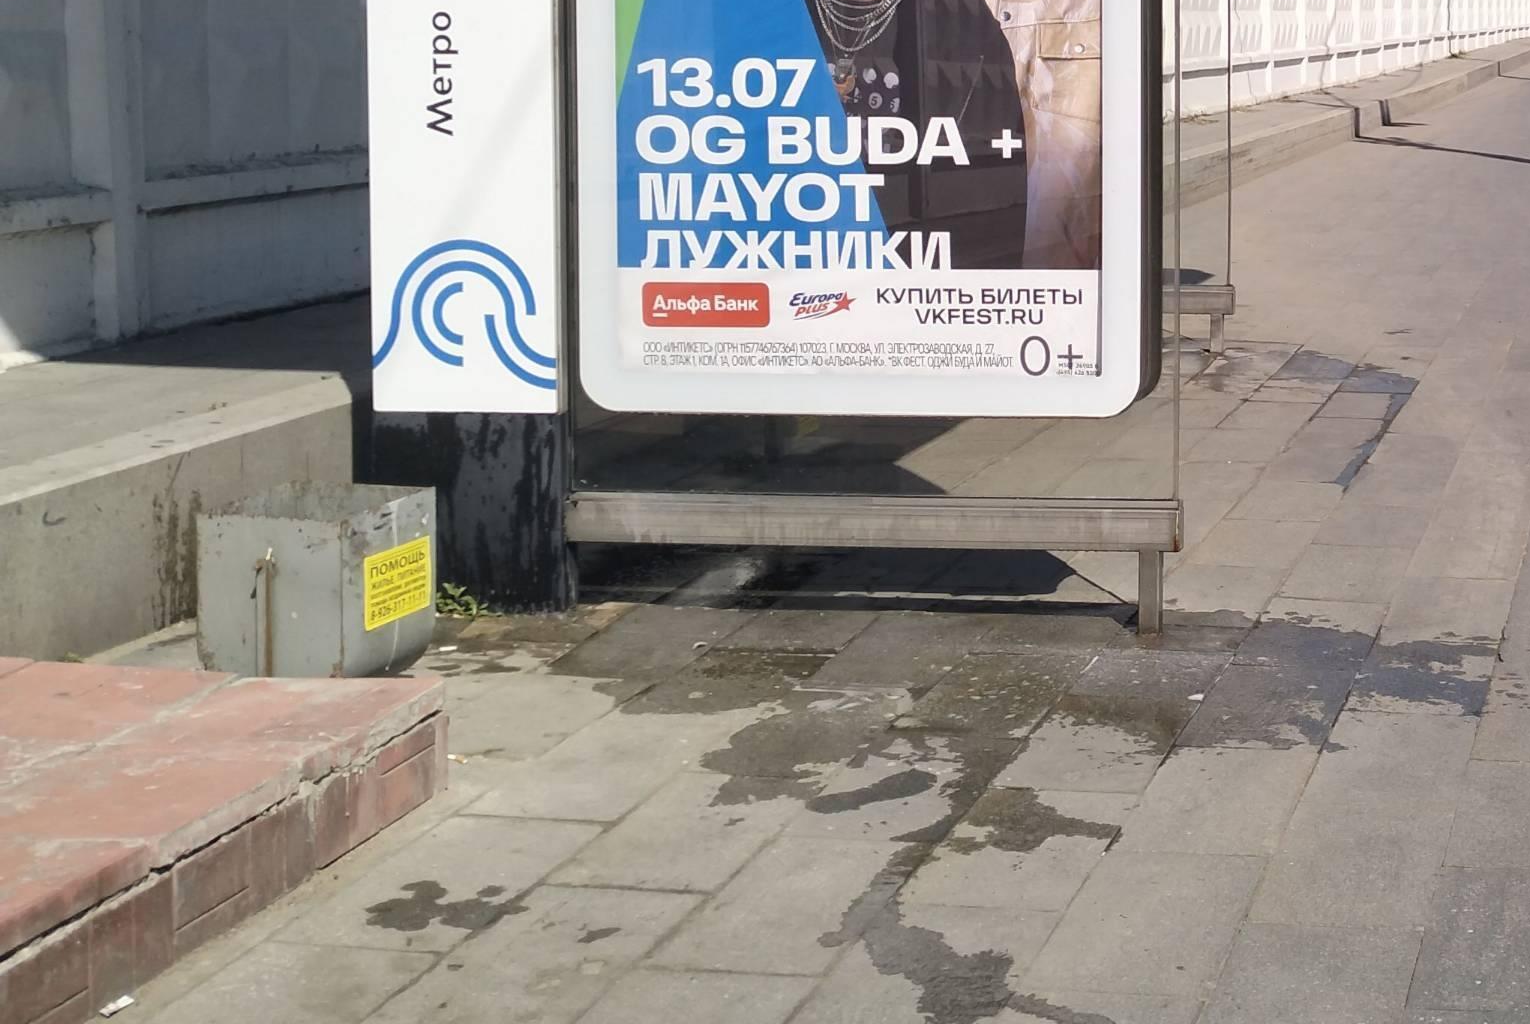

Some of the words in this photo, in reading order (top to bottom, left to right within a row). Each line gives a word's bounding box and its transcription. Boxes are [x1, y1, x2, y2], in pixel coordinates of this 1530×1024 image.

[426, 9, 459, 137] Метро
[636, 58, 816, 107] 13.07
[635, 115, 746, 164] OG
[767, 115, 970, 166] BUDA
[639, 172, 885, 222] MAYOT
[640, 229, 951, 270] ЛУЖНИКИ
[652, 294, 711, 317] Альфа
[713, 294, 759, 312] Банк
[789, 292, 844, 307] Europa
[876, 287, 974, 305] КУПИТЬ
[981, 288, 1083, 305] БИЛЕТЫ
[914, 308, 1044, 325] VKFEST.RU
[643, 341, 662, 353] ООО
[731, 355, 757, 367] ОФИС
[811, 355, 824, 367] АО
[954, 356, 975, 369] БУДА
[1020, 335, 1083, 376] 0+
[370, 549, 426, 579] ПОМОЩЬ
